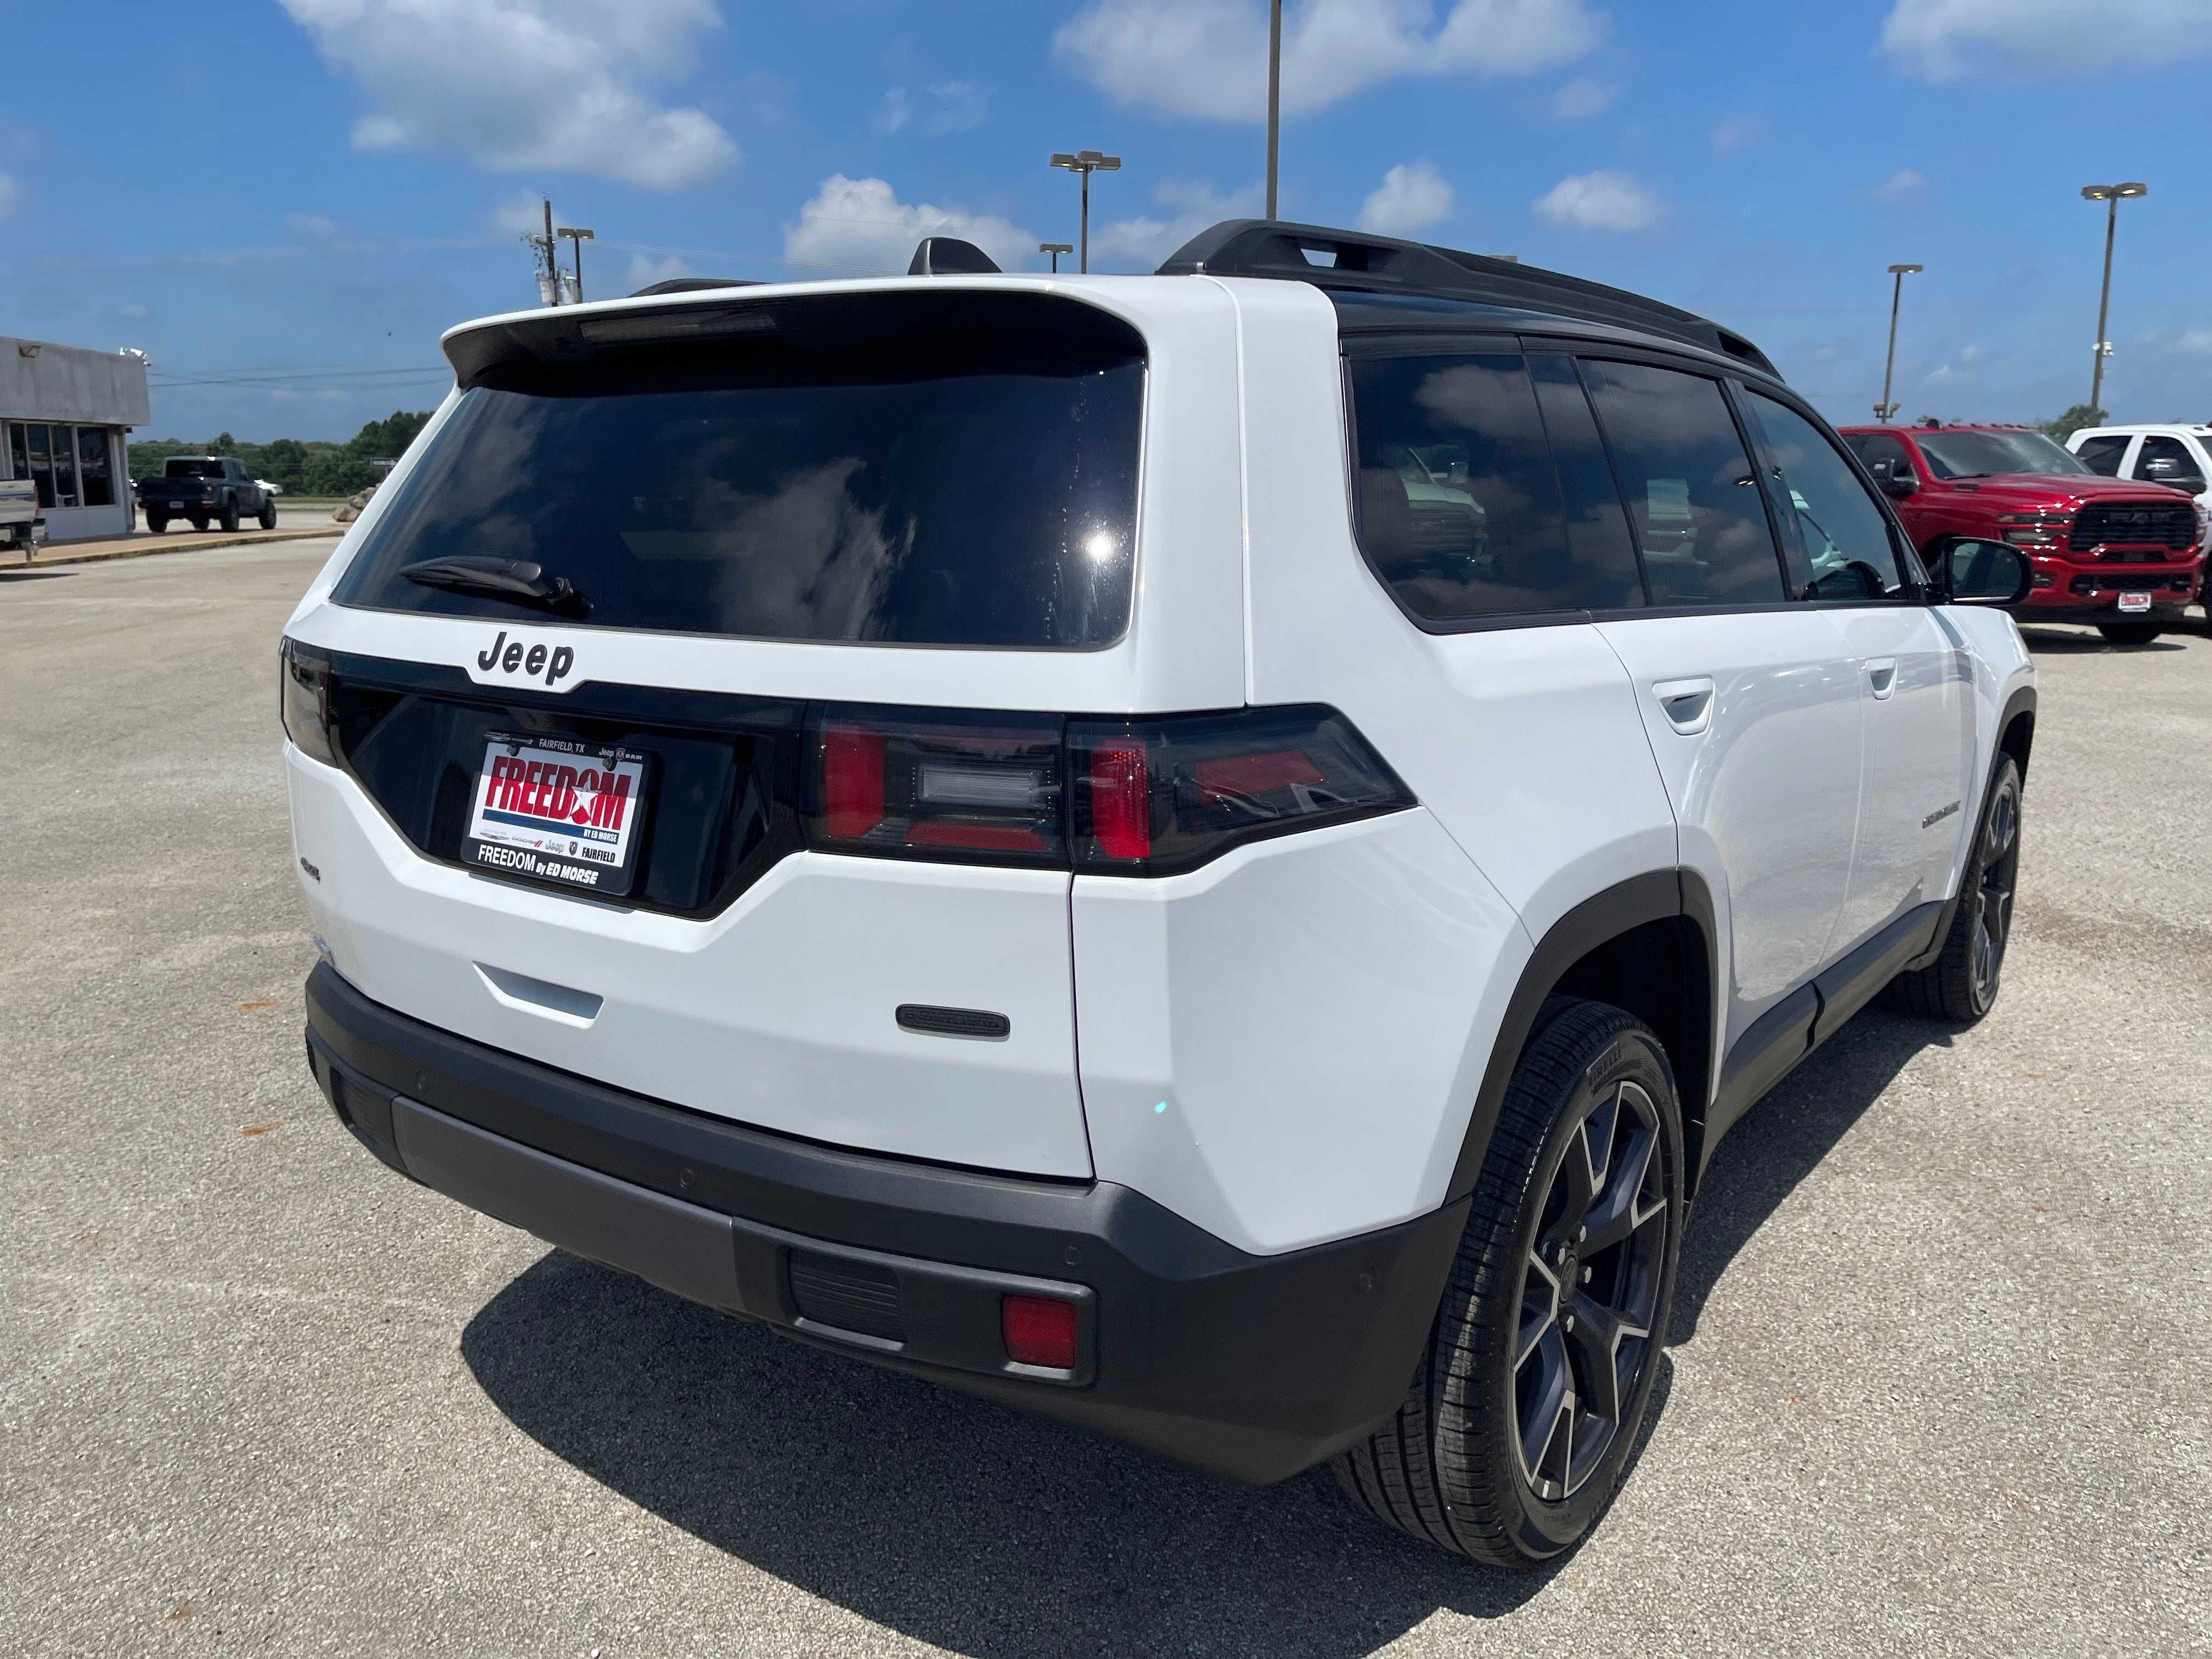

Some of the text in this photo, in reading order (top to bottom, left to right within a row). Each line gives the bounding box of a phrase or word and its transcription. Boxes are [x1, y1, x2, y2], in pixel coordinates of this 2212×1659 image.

[478, 631, 574, 686] Jeep
[539, 738, 573, 753] FAIRFIELD,
[575, 743, 585, 753] TX
[599, 748, 614, 758] Jeep
[485, 755, 631, 830] FREEDOM
[583, 828, 618, 843] BY ED MORSE
[545, 840, 565, 854] Jeep
[582, 847, 616, 863] FAIRFIELD
[477, 844, 537, 872] FREEDOM
[545, 862, 562, 877] ED
[560, 865, 599, 885] MORSE
